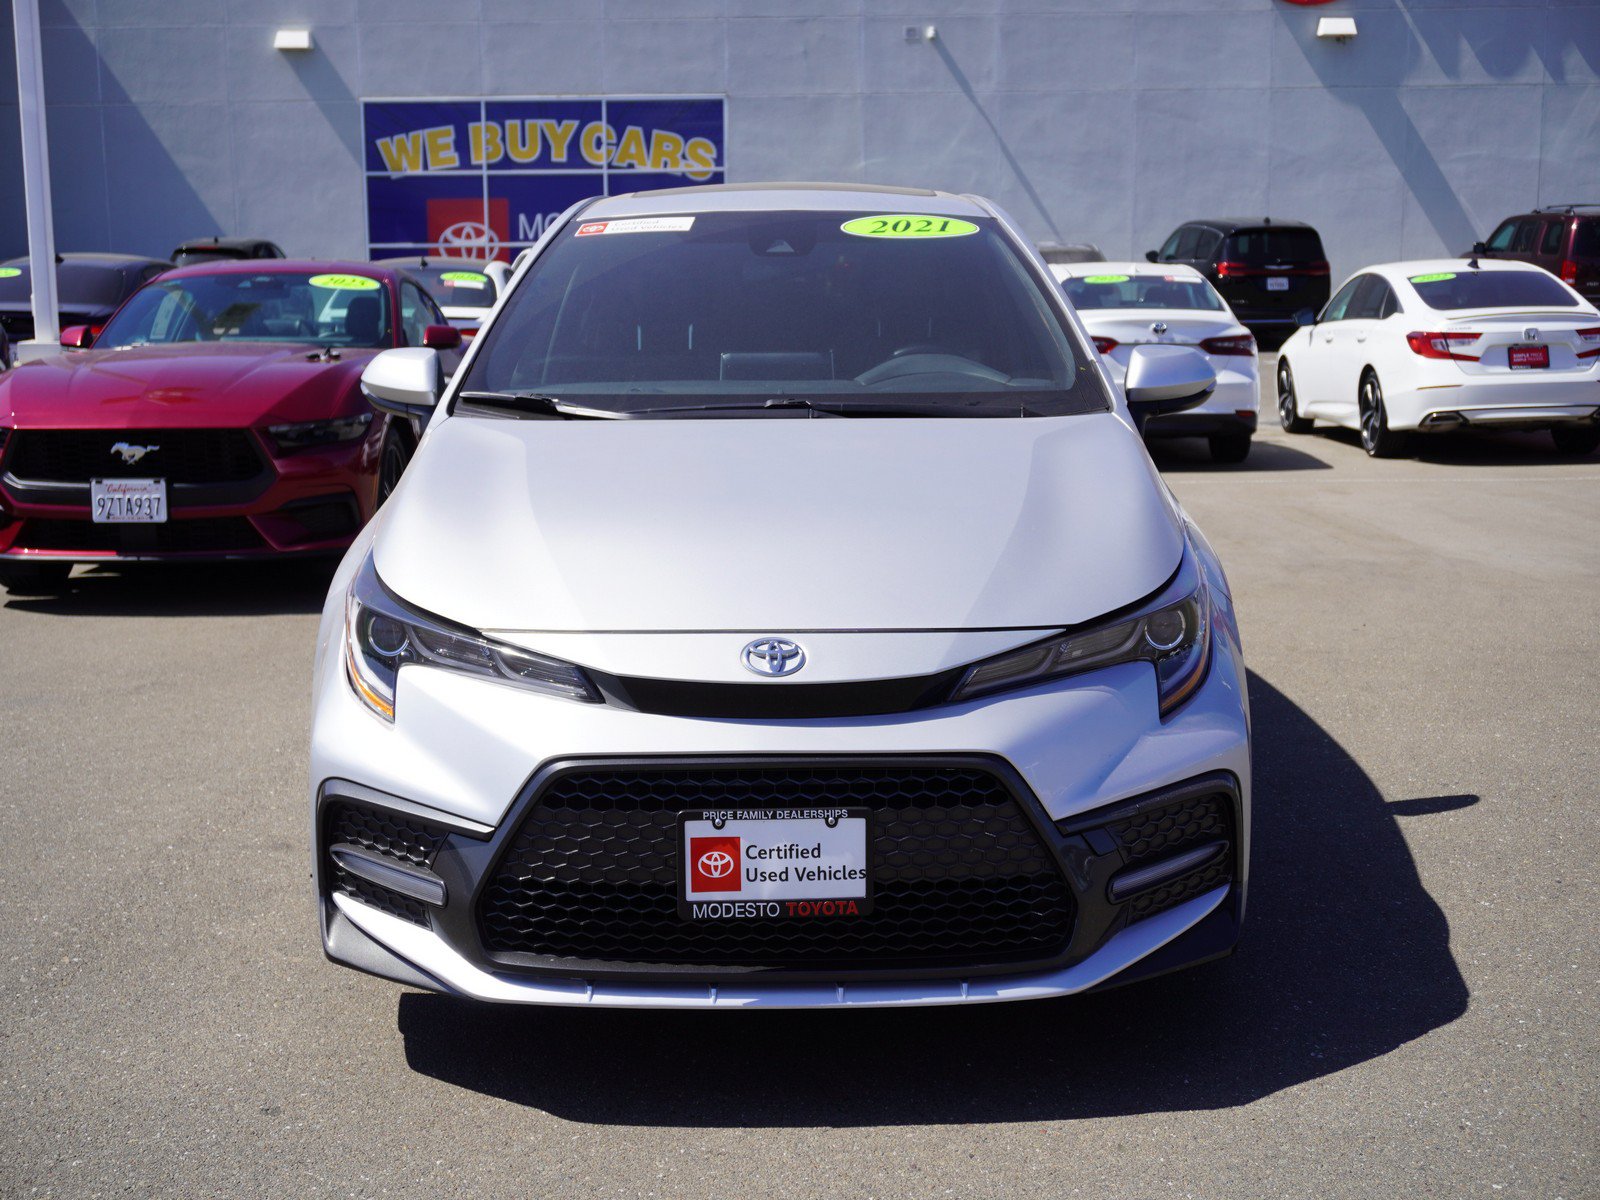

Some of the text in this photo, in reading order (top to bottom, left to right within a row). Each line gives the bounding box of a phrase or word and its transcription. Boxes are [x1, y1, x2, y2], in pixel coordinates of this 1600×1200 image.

[375, 119, 718, 182] WE BUY CARS
[869, 219, 950, 233] 2021
[106, 484, 147, 496] California
[97, 496, 161, 516] 9ZTA937
[703, 809, 849, 820] PRICE FAMILY DEALERSHIPS
[745, 843, 821, 860] Certified
[746, 865, 867, 883] Used Vehicles
[692, 900, 859, 919] MODESTO TOYOTA
